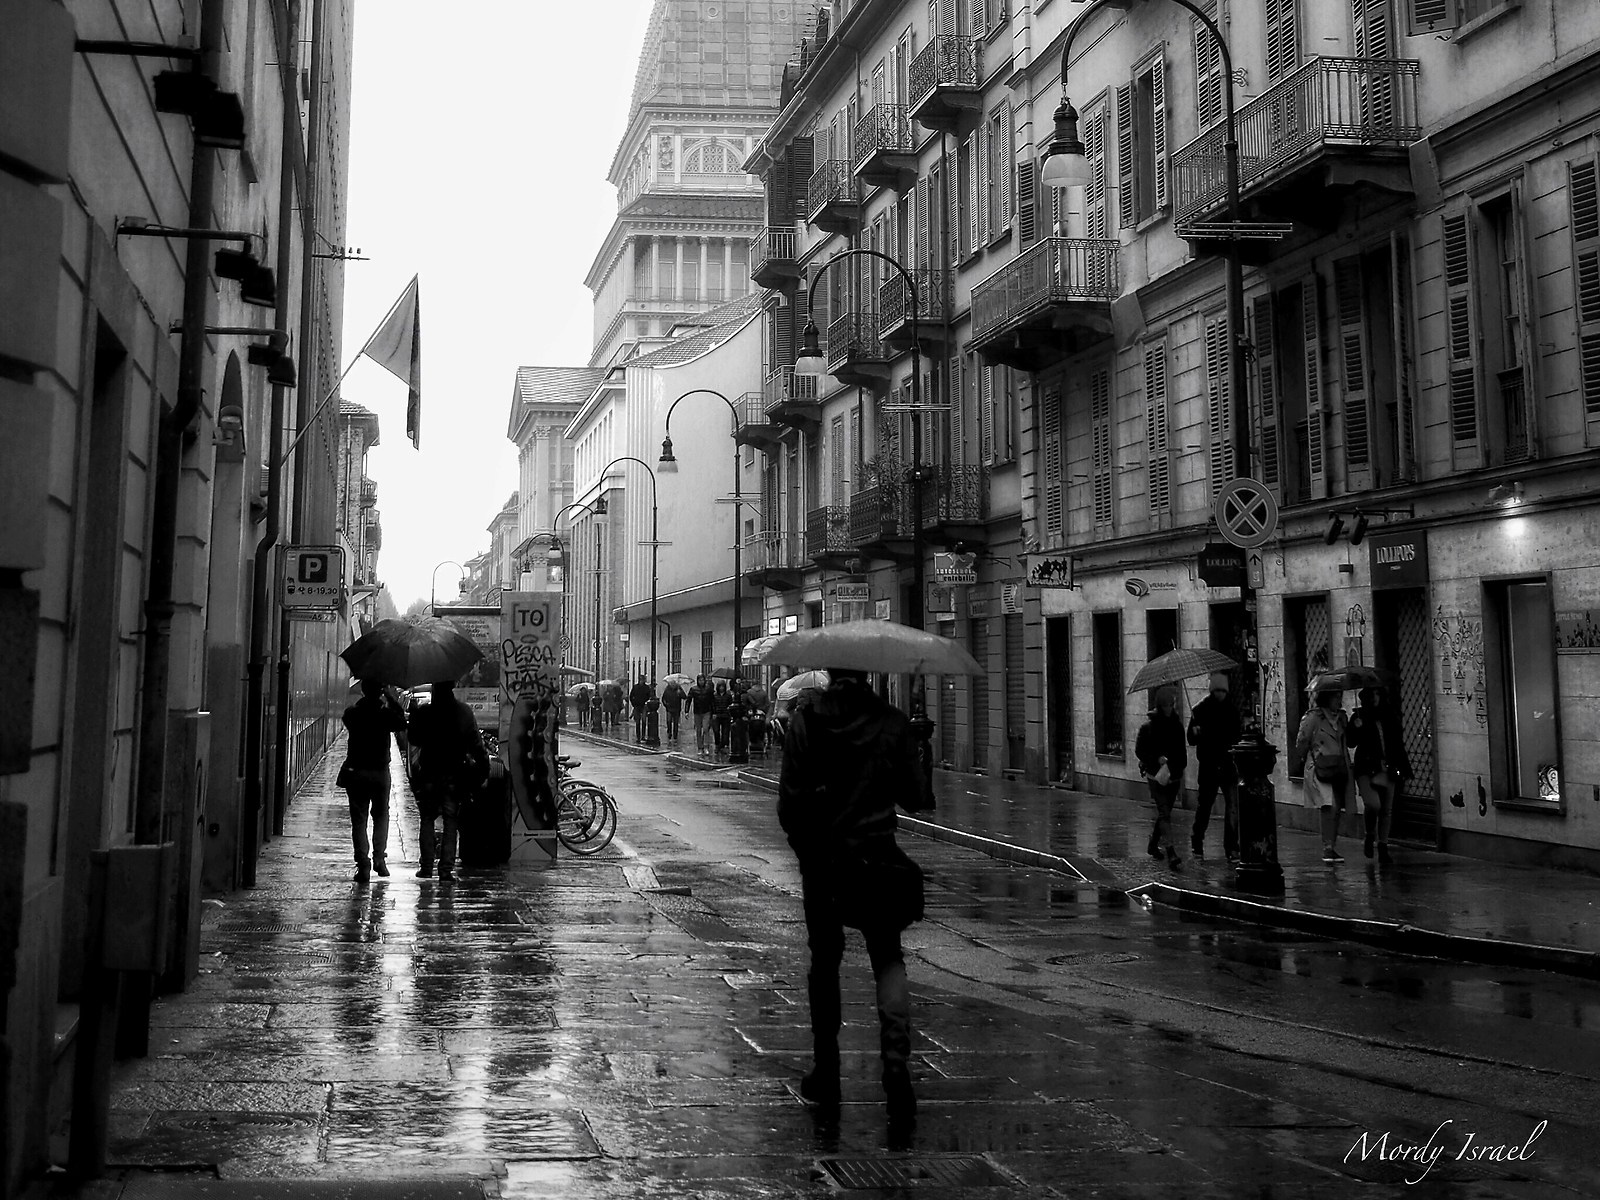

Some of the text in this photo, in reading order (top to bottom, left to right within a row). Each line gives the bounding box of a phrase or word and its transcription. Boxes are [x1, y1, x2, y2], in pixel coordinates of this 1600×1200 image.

[1206, 558, 1241, 567] LOLLIPO
[305, 557, 322, 580] P
[307, 586, 337, 595] 8-19.30
